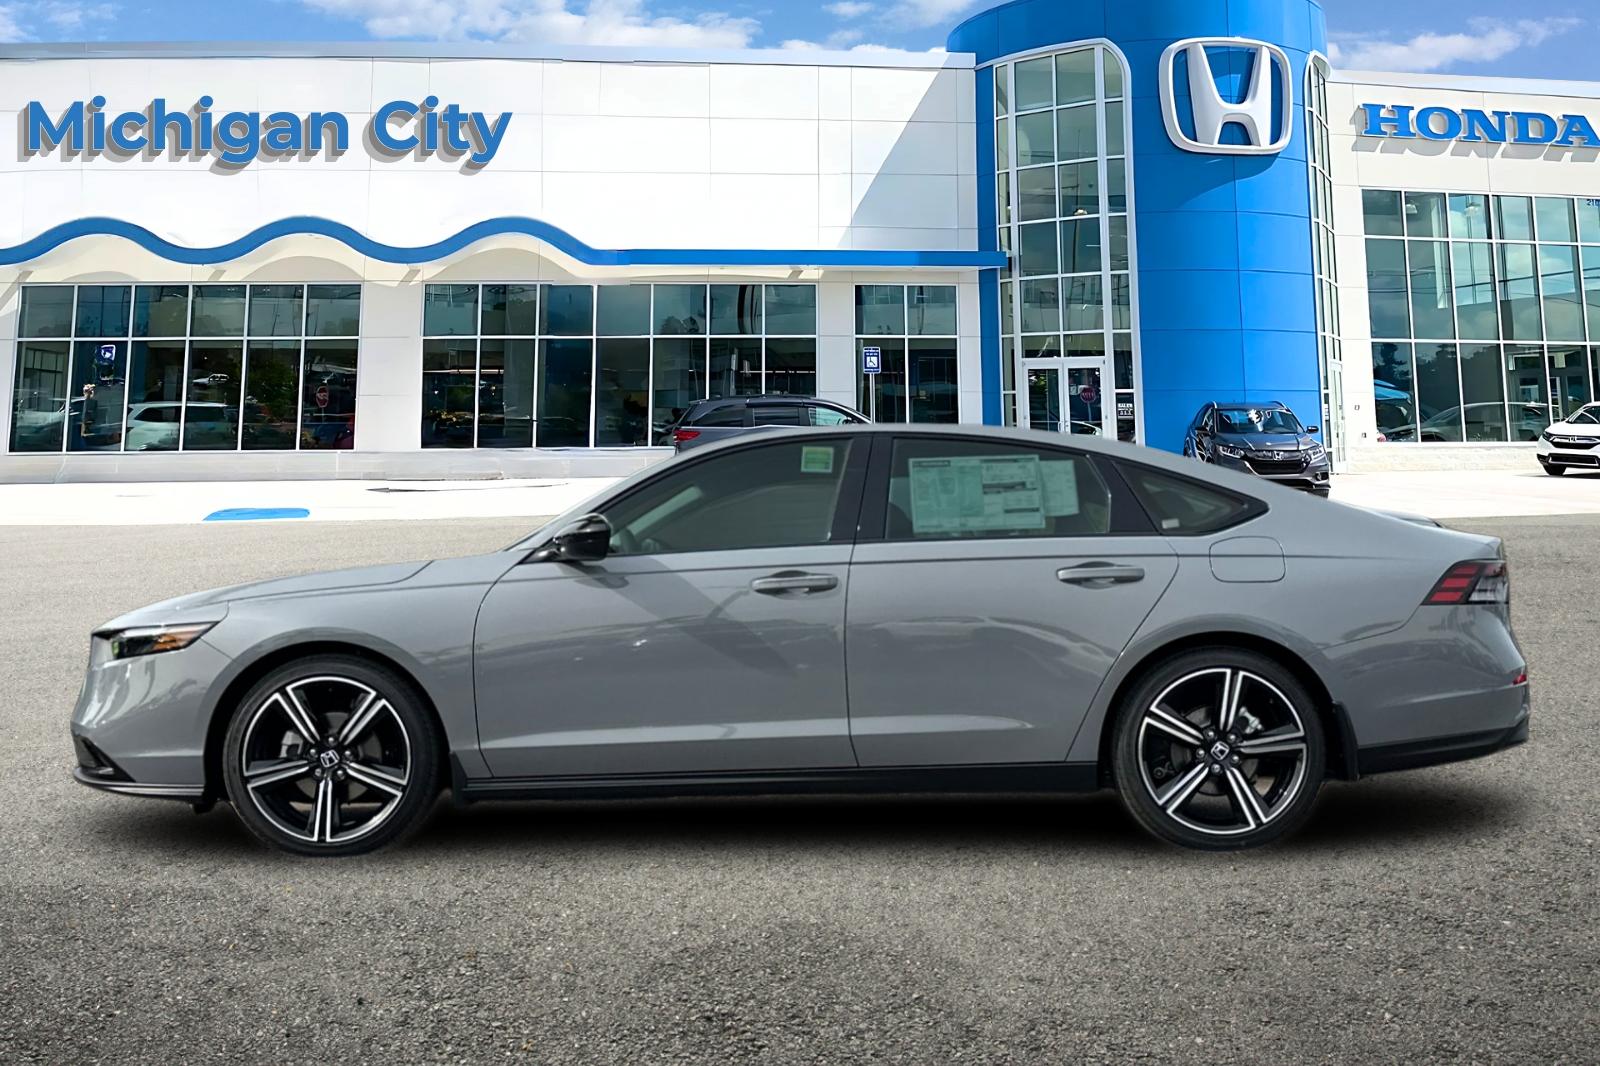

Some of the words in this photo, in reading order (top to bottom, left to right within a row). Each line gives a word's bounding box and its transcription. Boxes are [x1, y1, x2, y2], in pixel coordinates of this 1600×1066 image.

[28, 95, 349, 164] Michigan
[373, 95, 514, 164] City
[1361, 103, 1600, 147] HONDA
